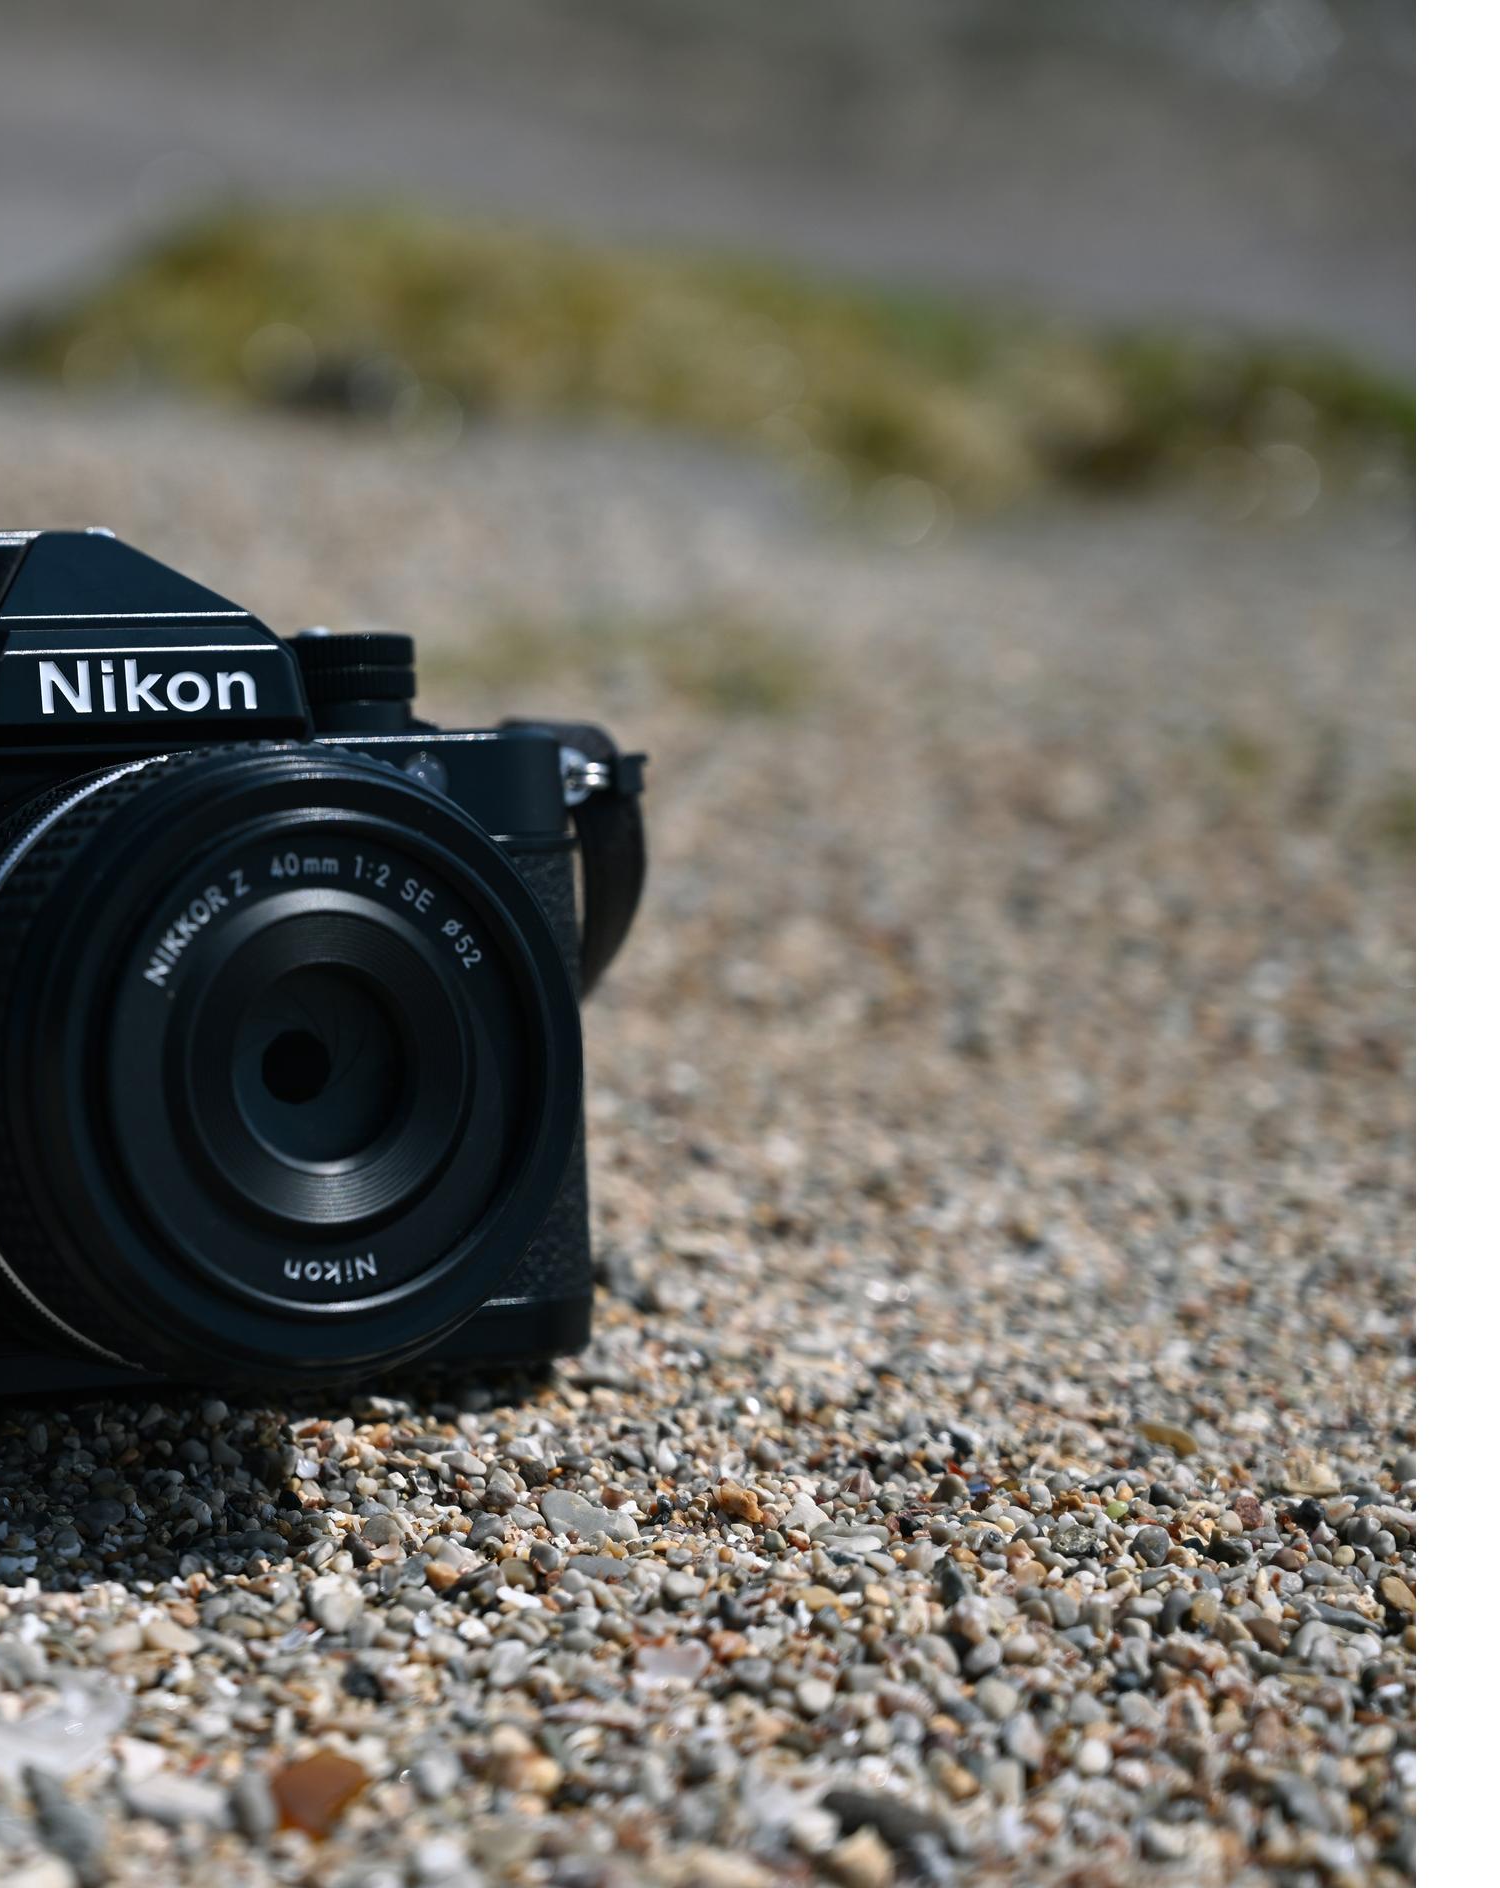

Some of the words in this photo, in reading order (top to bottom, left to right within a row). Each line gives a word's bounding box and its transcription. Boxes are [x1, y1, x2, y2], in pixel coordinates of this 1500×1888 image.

[38, 658, 258, 715] Nikon
[143, 885, 229, 987] NIKKOR
[228, 869, 252, 898] Z
[269, 852, 340, 880] 40mm
[354, 855, 392, 889] 1:2
[400, 877, 436, 914] SE
[283, 1251, 378, 1286] Nikon
